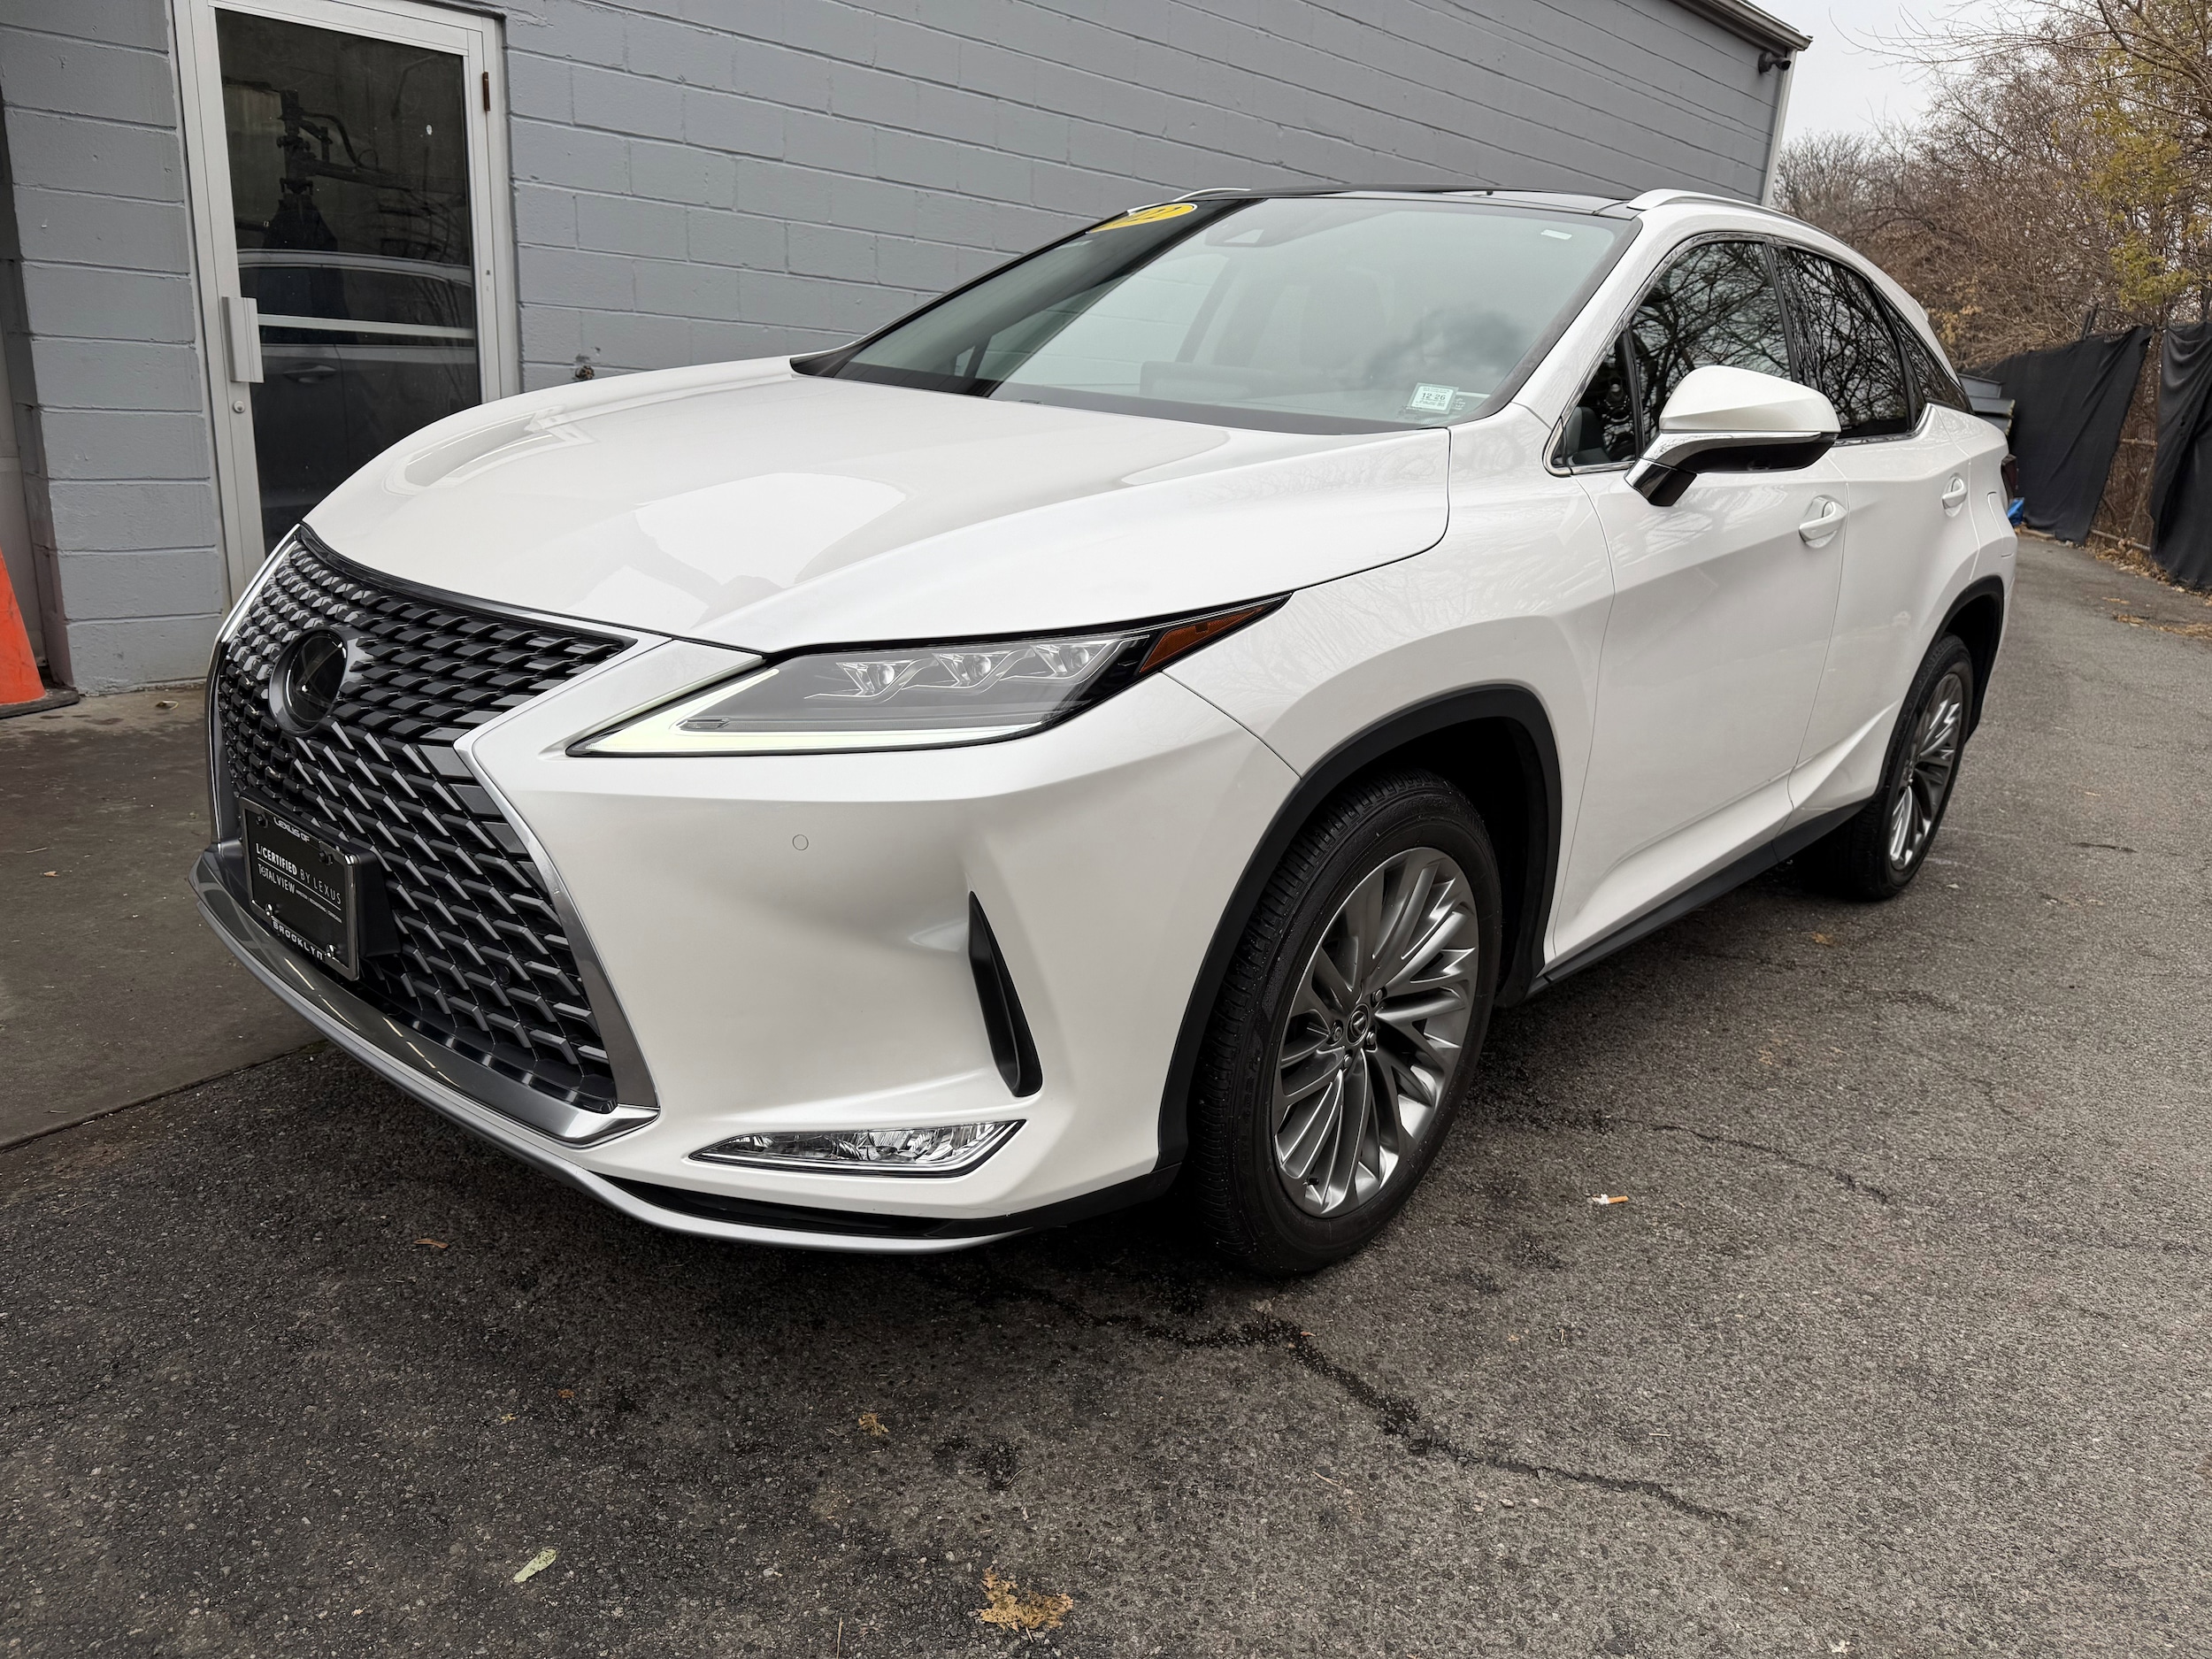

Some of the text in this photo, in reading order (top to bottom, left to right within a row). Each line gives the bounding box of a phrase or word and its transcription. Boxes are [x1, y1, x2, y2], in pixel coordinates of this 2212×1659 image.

[273, 817, 311, 842] LEXUS OF
[256, 843, 342, 904] L/CERTIFIED BY LEXUS
[273, 921, 323, 961] BROOKLYN
